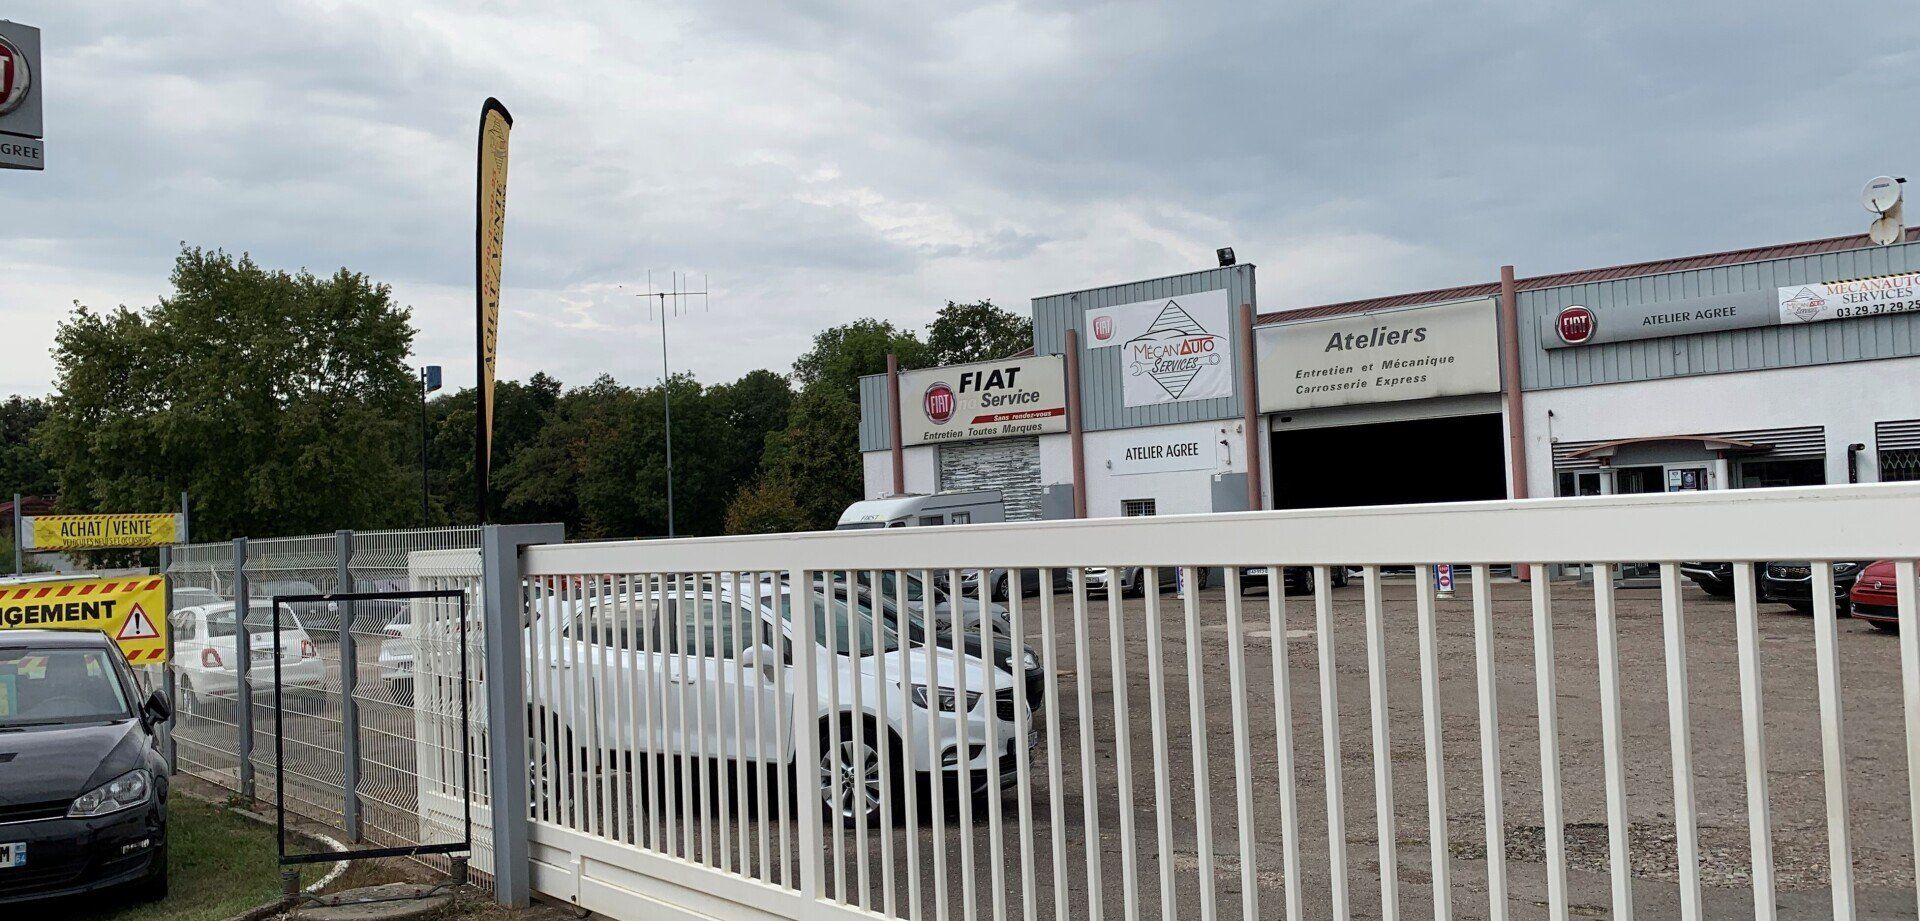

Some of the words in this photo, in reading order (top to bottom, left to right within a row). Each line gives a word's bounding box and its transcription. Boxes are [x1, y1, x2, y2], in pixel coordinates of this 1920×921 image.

[485, 281, 497, 372] ACHAT
[491, 180, 503, 260] VENTE
[1842, 287, 1913, 304] SERVICES
[1642, 312, 1690, 326] ATELIER
[1695, 306, 1737, 320] AGREE
[1836, 300, 1920, 318] 03.29.37.29.25
[1095, 320, 1111, 335] FIAT
[1563, 315, 1588, 335] FIAT
[1325, 326, 1427, 353] Ateliers
[1152, 357, 1199, 373] SERVICES
[1295, 365, 1353, 379] Entretien
[1361, 363, 1374, 372] et
[1381, 355, 1455, 370] Mécanique
[959, 367, 1021, 393] FIAT
[1296, 379, 1368, 395] Carrosserie
[1375, 374, 1427, 387] Express
[930, 394, 950, 415] FIAT
[981, 389, 1040, 408] Service
[993, 414, 1009, 422] Sans
[1012, 410, 1052, 420] rendez-vous
[923, 429, 963, 441] Entretien
[968, 426, 998, 437] Toutes
[1002, 423, 1043, 434] Marques
[1126, 445, 1163, 460] ATELIER
[1166, 442, 1199, 458] AGREE
[60, 521, 101, 537] ACHAT
[113, 519, 152, 535] VENTE
[0, 600, 117, 627] GEMENT
